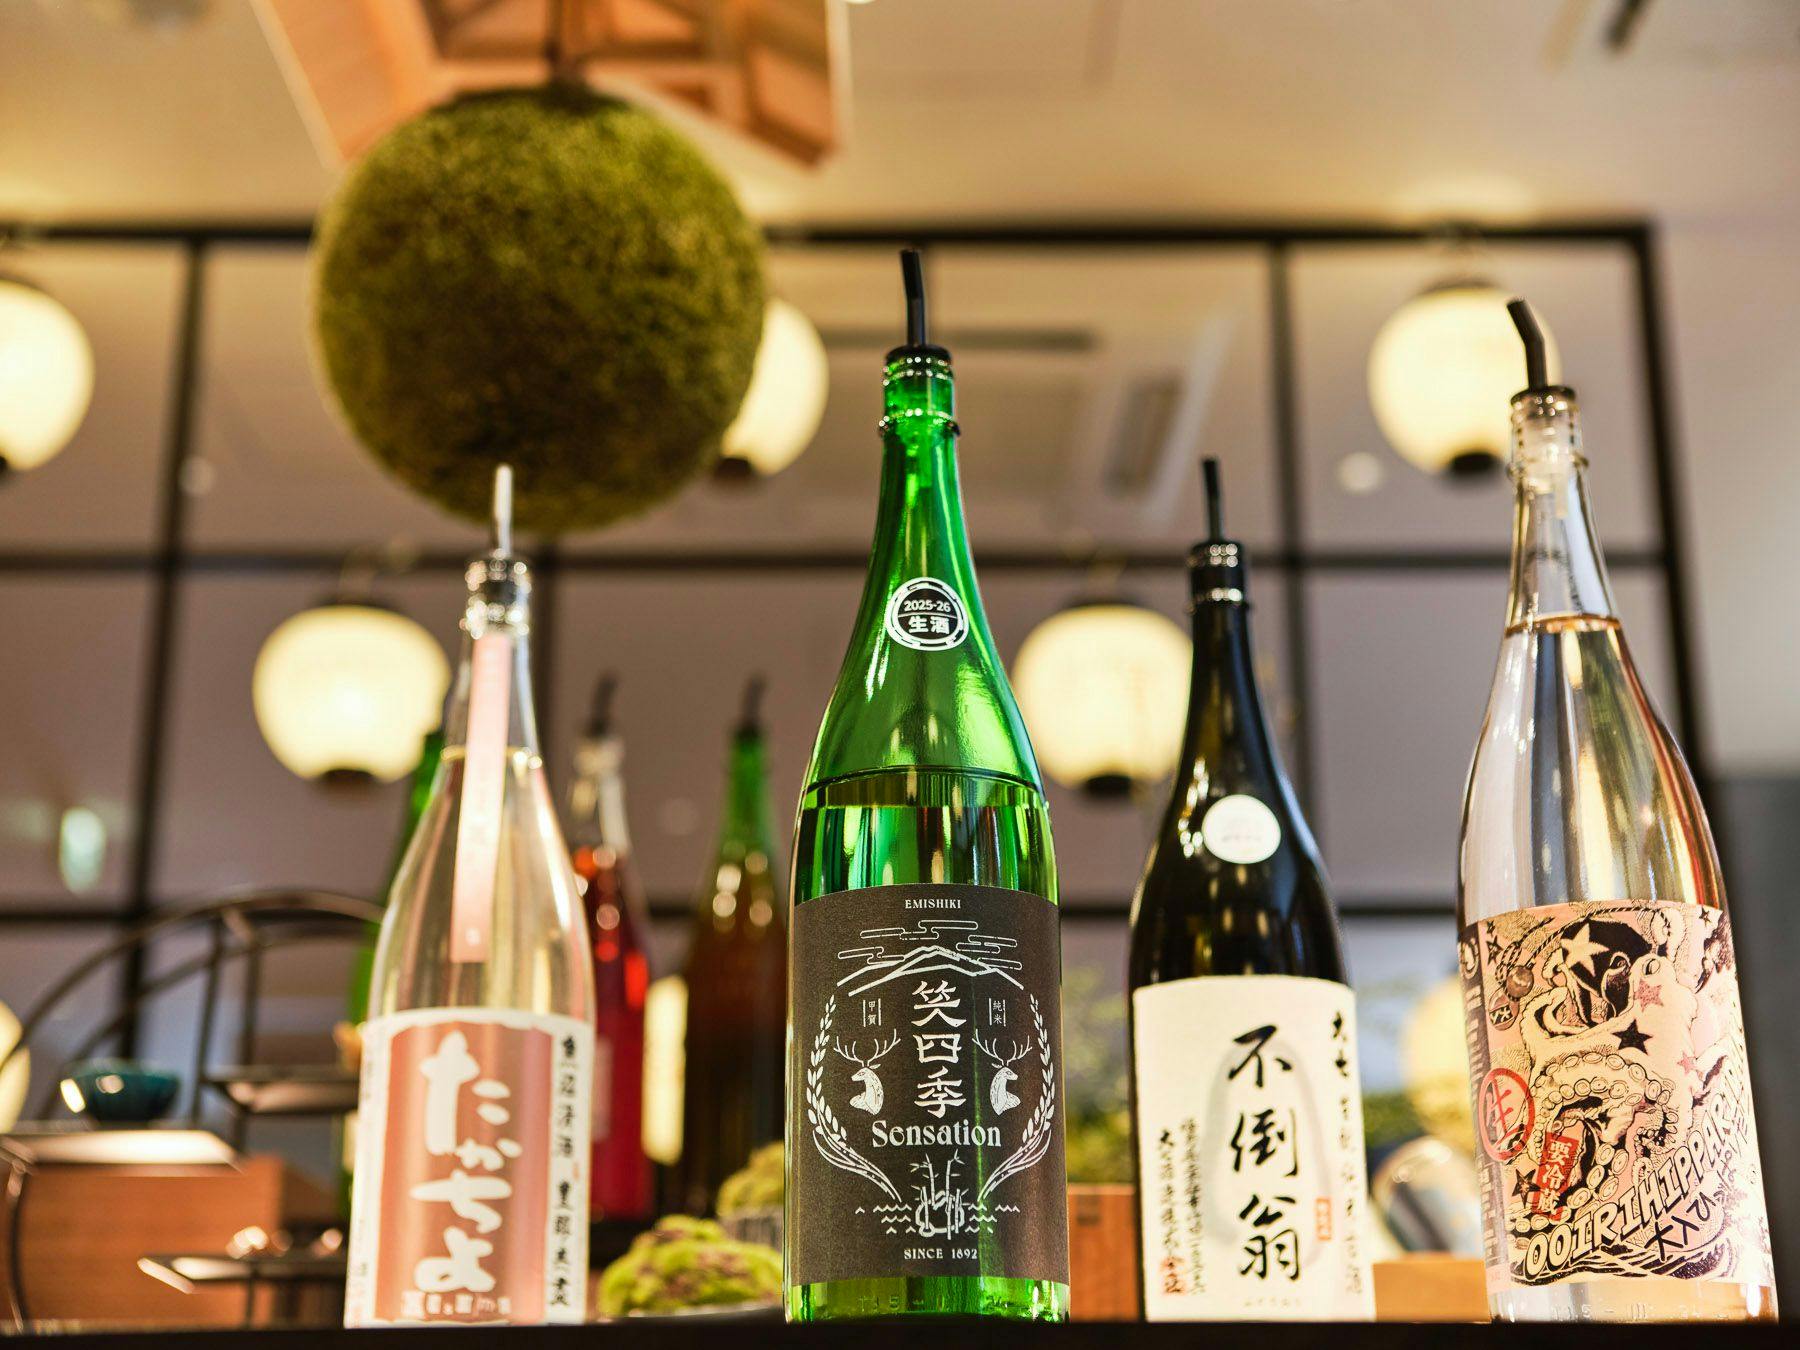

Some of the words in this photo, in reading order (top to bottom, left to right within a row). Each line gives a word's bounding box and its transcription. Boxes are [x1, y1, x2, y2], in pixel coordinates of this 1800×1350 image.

[904, 599, 951, 612] 2025-26
[908, 615, 950, 634] 生酒
[905, 898, 961, 909] EMISHIKI
[911, 979, 968, 1119] 笑四季
[871, 1118, 1002, 1148] Sensation
[1227, 1024, 1300, 1282] 不倒翁
[1537, 1141, 1573, 1217] 要冷蔵
[903, 1247, 944, 1260] SINCE
[951, 1247, 978, 1260] 1892
